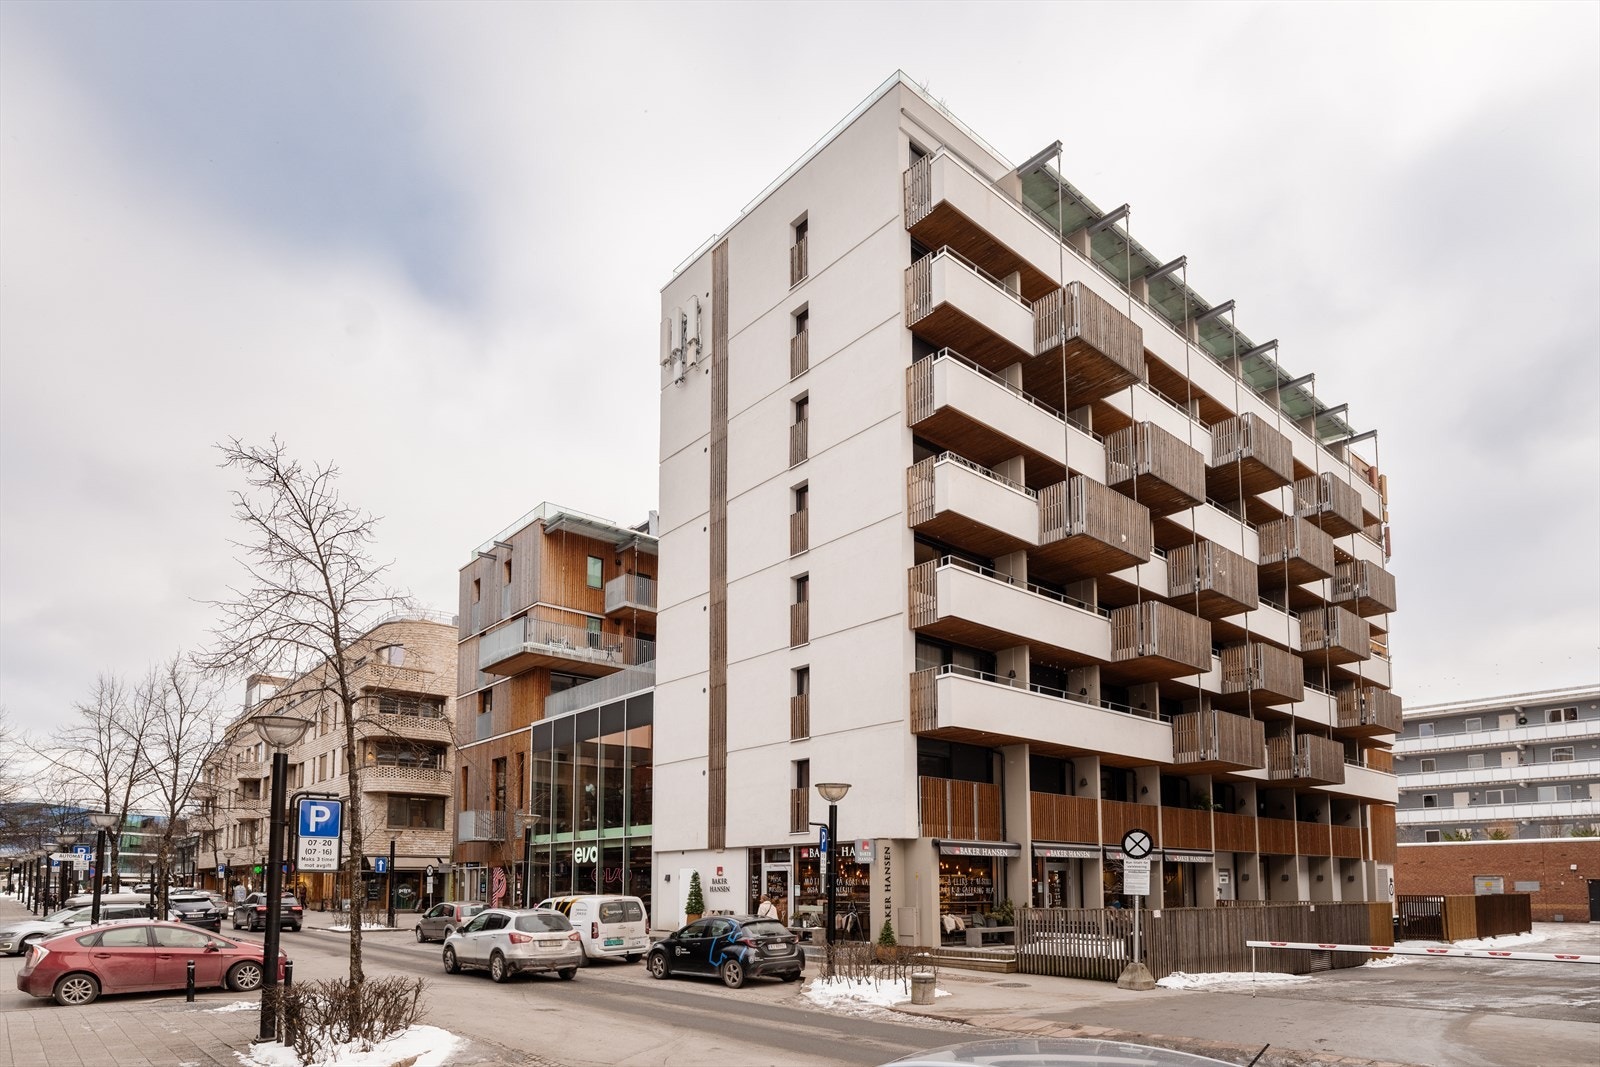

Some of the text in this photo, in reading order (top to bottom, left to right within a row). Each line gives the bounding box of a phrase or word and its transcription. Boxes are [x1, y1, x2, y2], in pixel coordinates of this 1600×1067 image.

[309, 805, 331, 832] P
[304, 848, 317, 856] (07
[322, 848, 333, 856] 16)
[574, 846, 598, 864] evo
[959, 847, 1008, 857] BAKER HANSEN
[1050, 849, 1090, 858] BAKER HANSEN
[884, 846, 892, 892] HANSEN
[709, 885, 730, 893] HANSEN
